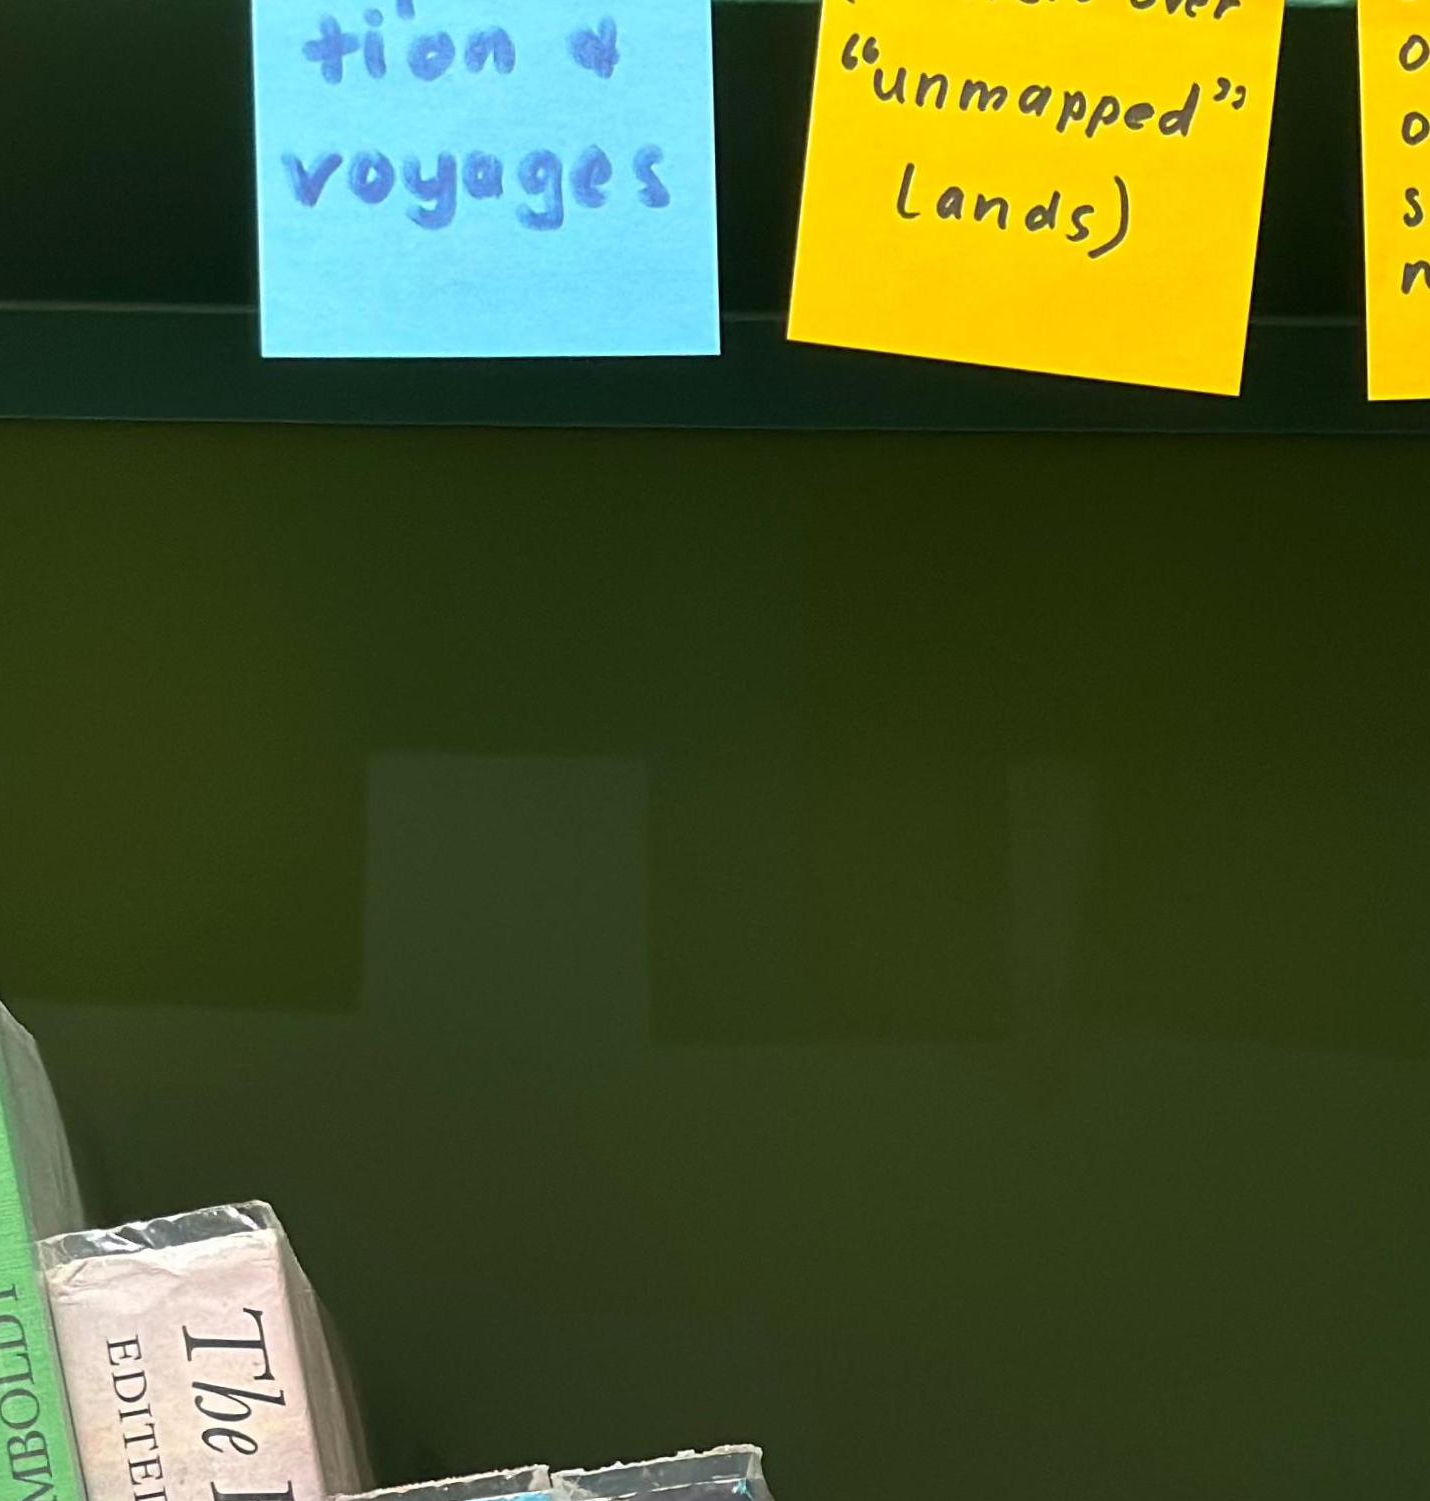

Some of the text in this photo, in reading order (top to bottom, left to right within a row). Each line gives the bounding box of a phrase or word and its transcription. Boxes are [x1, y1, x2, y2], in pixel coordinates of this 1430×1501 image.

[301, 8, 518, 86] tion
[281, 145, 672, 230] voyages
[898, 164, 1132, 258] lands)
[181, 1306, 286, 1458] The
